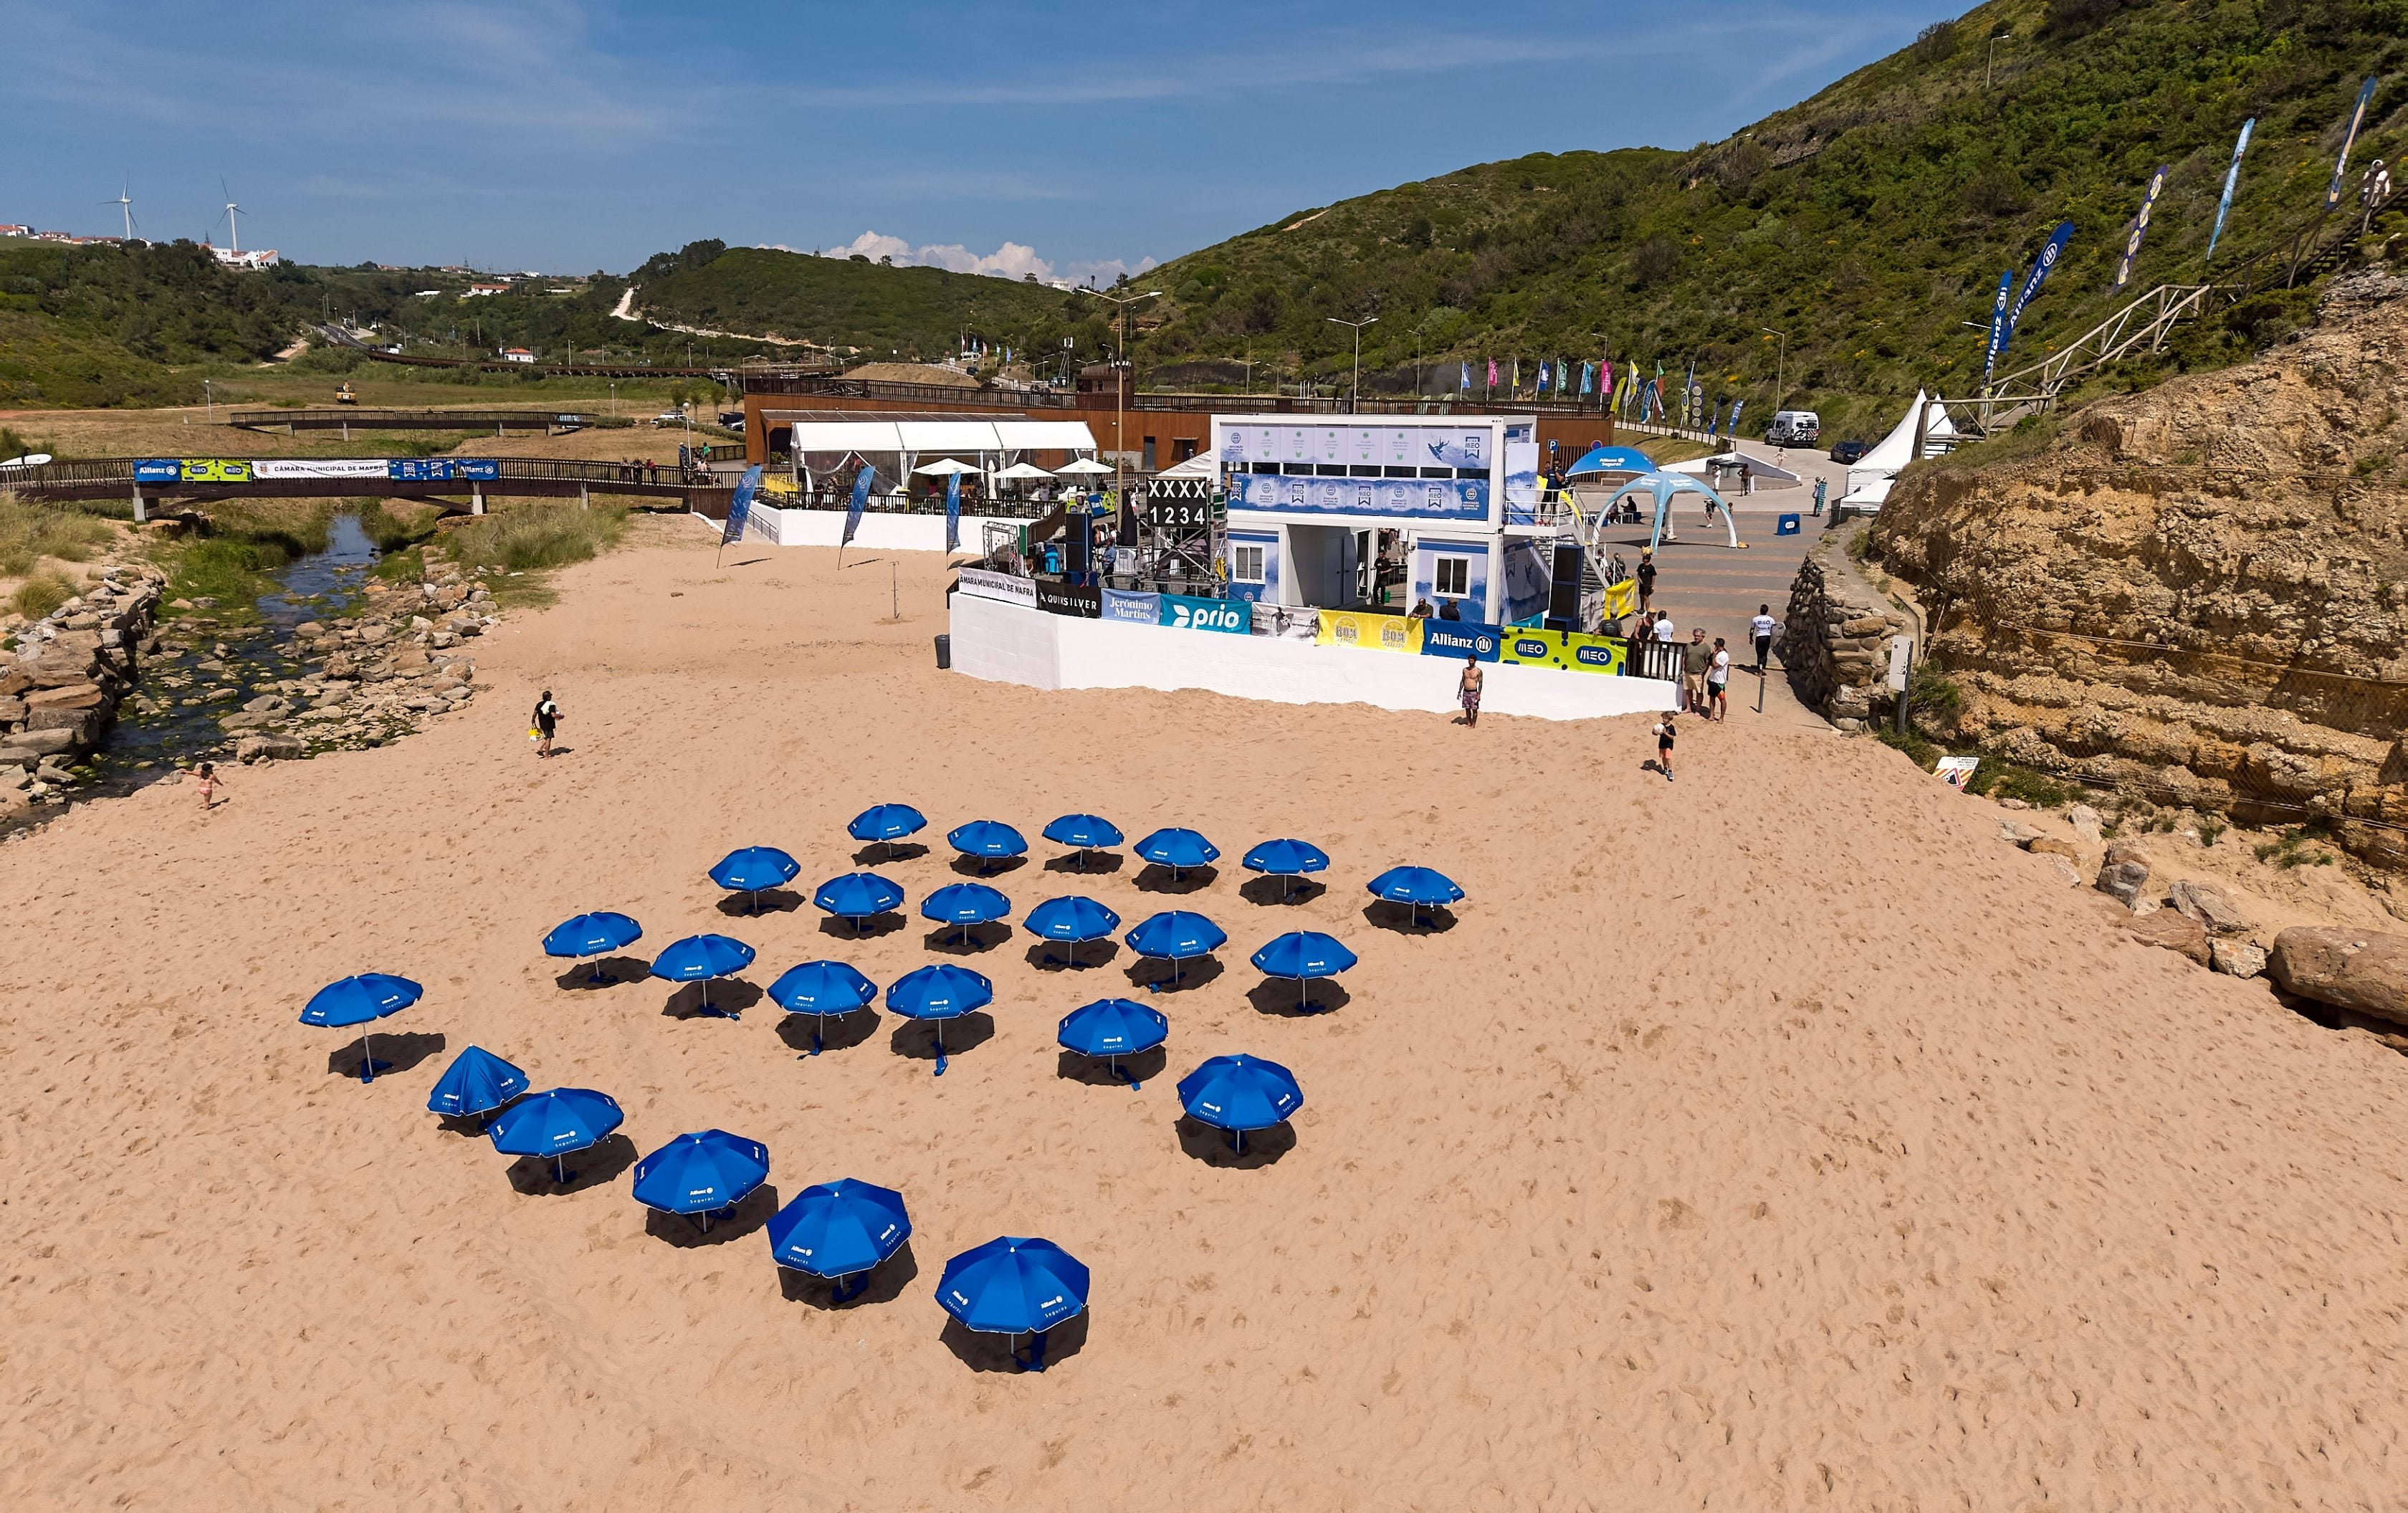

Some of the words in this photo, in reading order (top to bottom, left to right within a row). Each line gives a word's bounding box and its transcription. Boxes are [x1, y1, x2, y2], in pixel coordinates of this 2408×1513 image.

[2010, 267, 2042, 329] Allianz
[1549, 441, 1556, 449] P
[1148, 480, 1206, 498] XXXX
[1150, 506, 1205, 525] 1234
[958, 576, 978, 585] ÂMARA
[978, 580, 1005, 591] MUNICIPAL
[1007, 583, 1014, 592] DE
[1015, 586, 1033, 597] MAFRA
[1048, 594, 1097, 610] QUIKSILVER
[1109, 598, 1152, 610] Jerónimo
[1114, 607, 1151, 619] Martins
[1192, 603, 1239, 629] prio
[1336, 625, 1357, 639] BOM
[1382, 629, 1405, 643] BOM
[1430, 632, 1473, 649] Allianz
[1518, 643, 1544, 654] MEO
[1580, 649, 1607, 661] MEO
[1199, 1109, 1218, 1119] Seguros
[555, 1138, 578, 1147] Seguros
[886, 1231, 902, 1247] Seguros
[790, 1245, 806, 1254] Allianz
[788, 1254, 808, 1265] Seguros
[946, 1298, 962, 1314] Seguros
[1040, 1299, 1057, 1309] Allianz
[1044, 1306, 1068, 1318] Seguros
